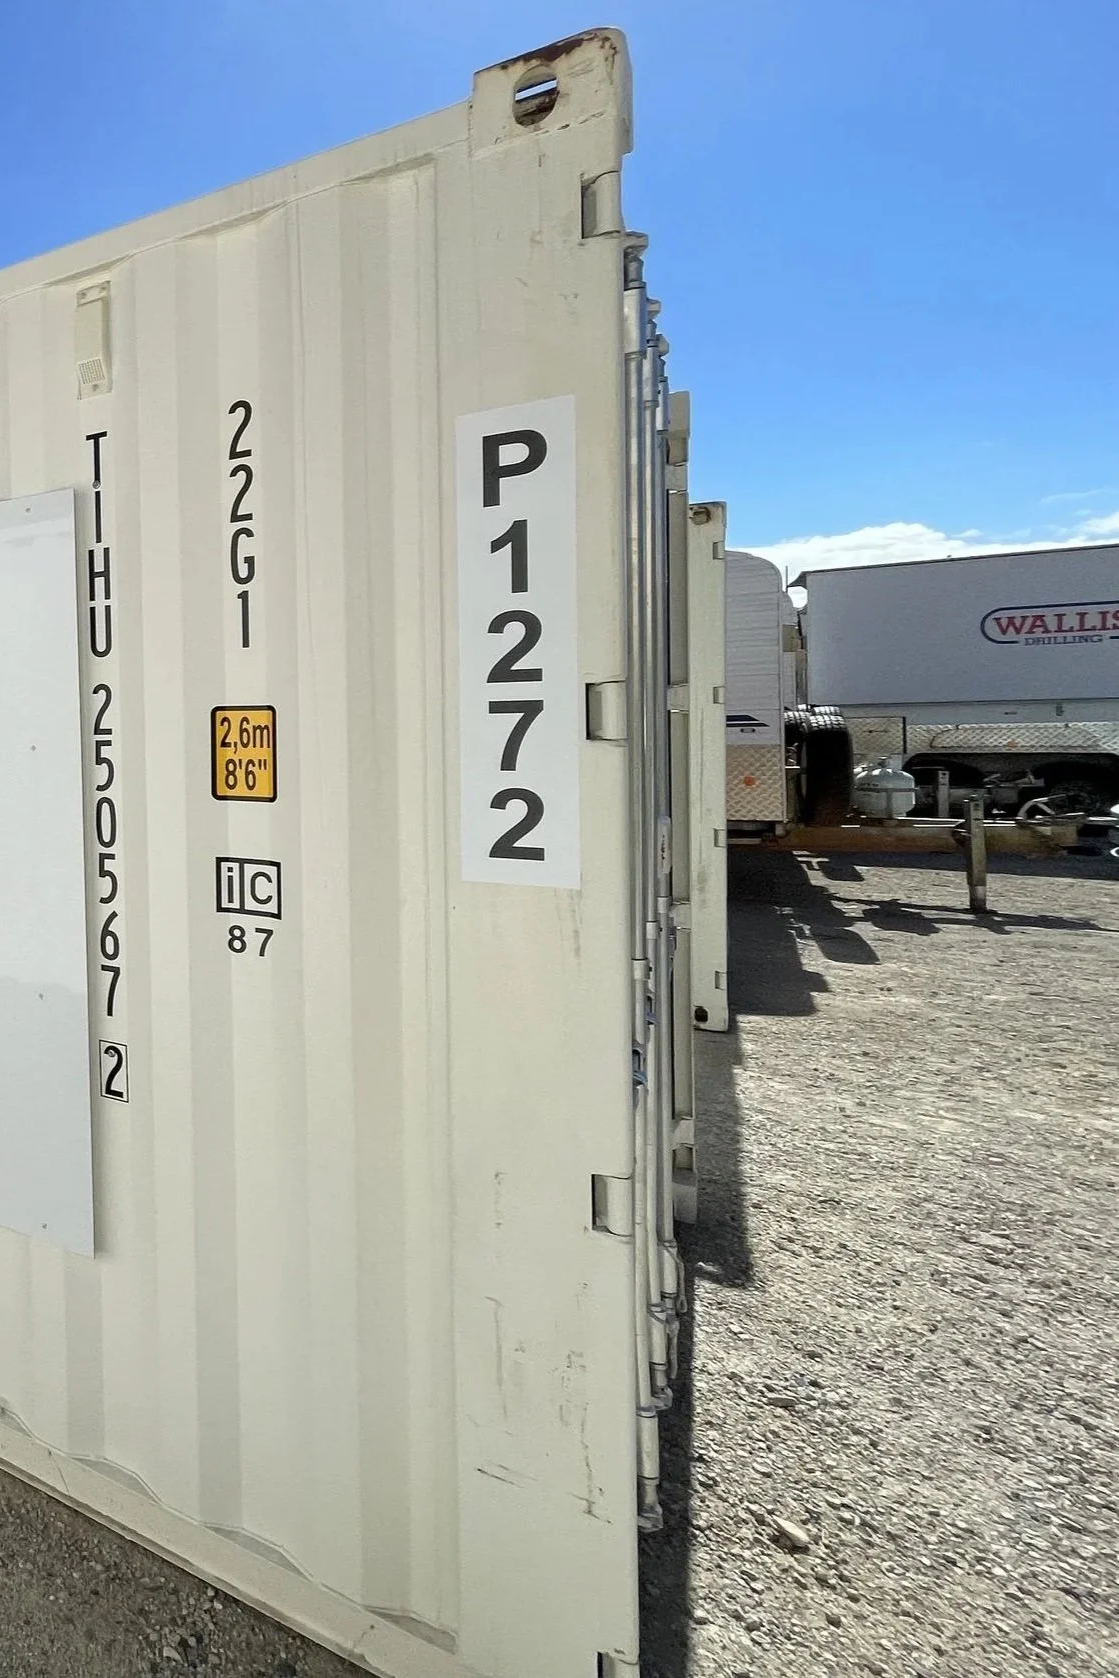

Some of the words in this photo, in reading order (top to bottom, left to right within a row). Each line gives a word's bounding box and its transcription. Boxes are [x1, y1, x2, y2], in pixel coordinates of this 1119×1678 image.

[85, 430, 112, 658] TIHU
[227, 400, 256, 649] 22G1
[481, 428, 548, 862] P1272
[1024, 634, 1103, 646] DRILLING
[219, 716, 271, 754] 2,6m
[224, 758, 268, 791] 8'6"
[92, 682, 121, 1017] 250567
[227, 924, 274, 957] 87
